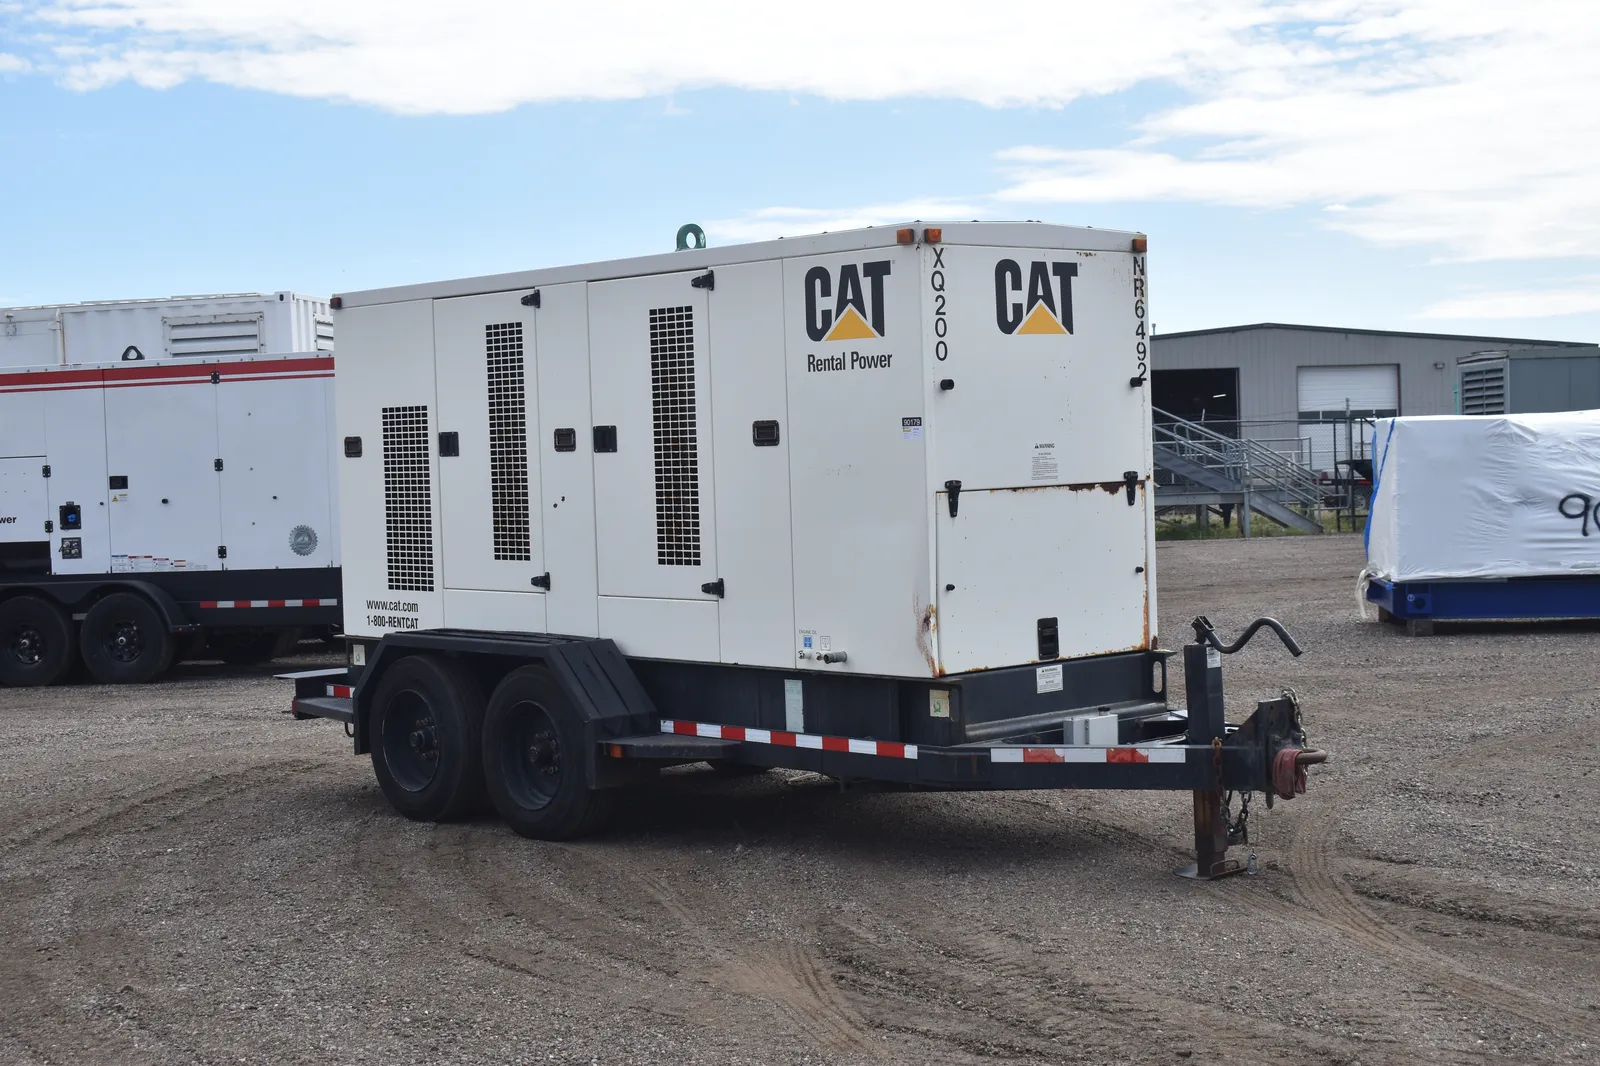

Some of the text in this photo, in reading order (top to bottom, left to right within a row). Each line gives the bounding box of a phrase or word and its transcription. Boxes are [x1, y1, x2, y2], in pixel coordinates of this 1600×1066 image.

[804, 260, 891, 342] CAT
[931, 247, 948, 361] XQ200
[995, 258, 1078, 335] CAT
[1133, 256, 1147, 381] NR6492
[807, 351, 893, 372] Rental Power
[1558, 494, 1600, 537] 9
[366, 600, 419, 613] www.cat.com
[366, 615, 419, 630] 1-800-RENTCAT
